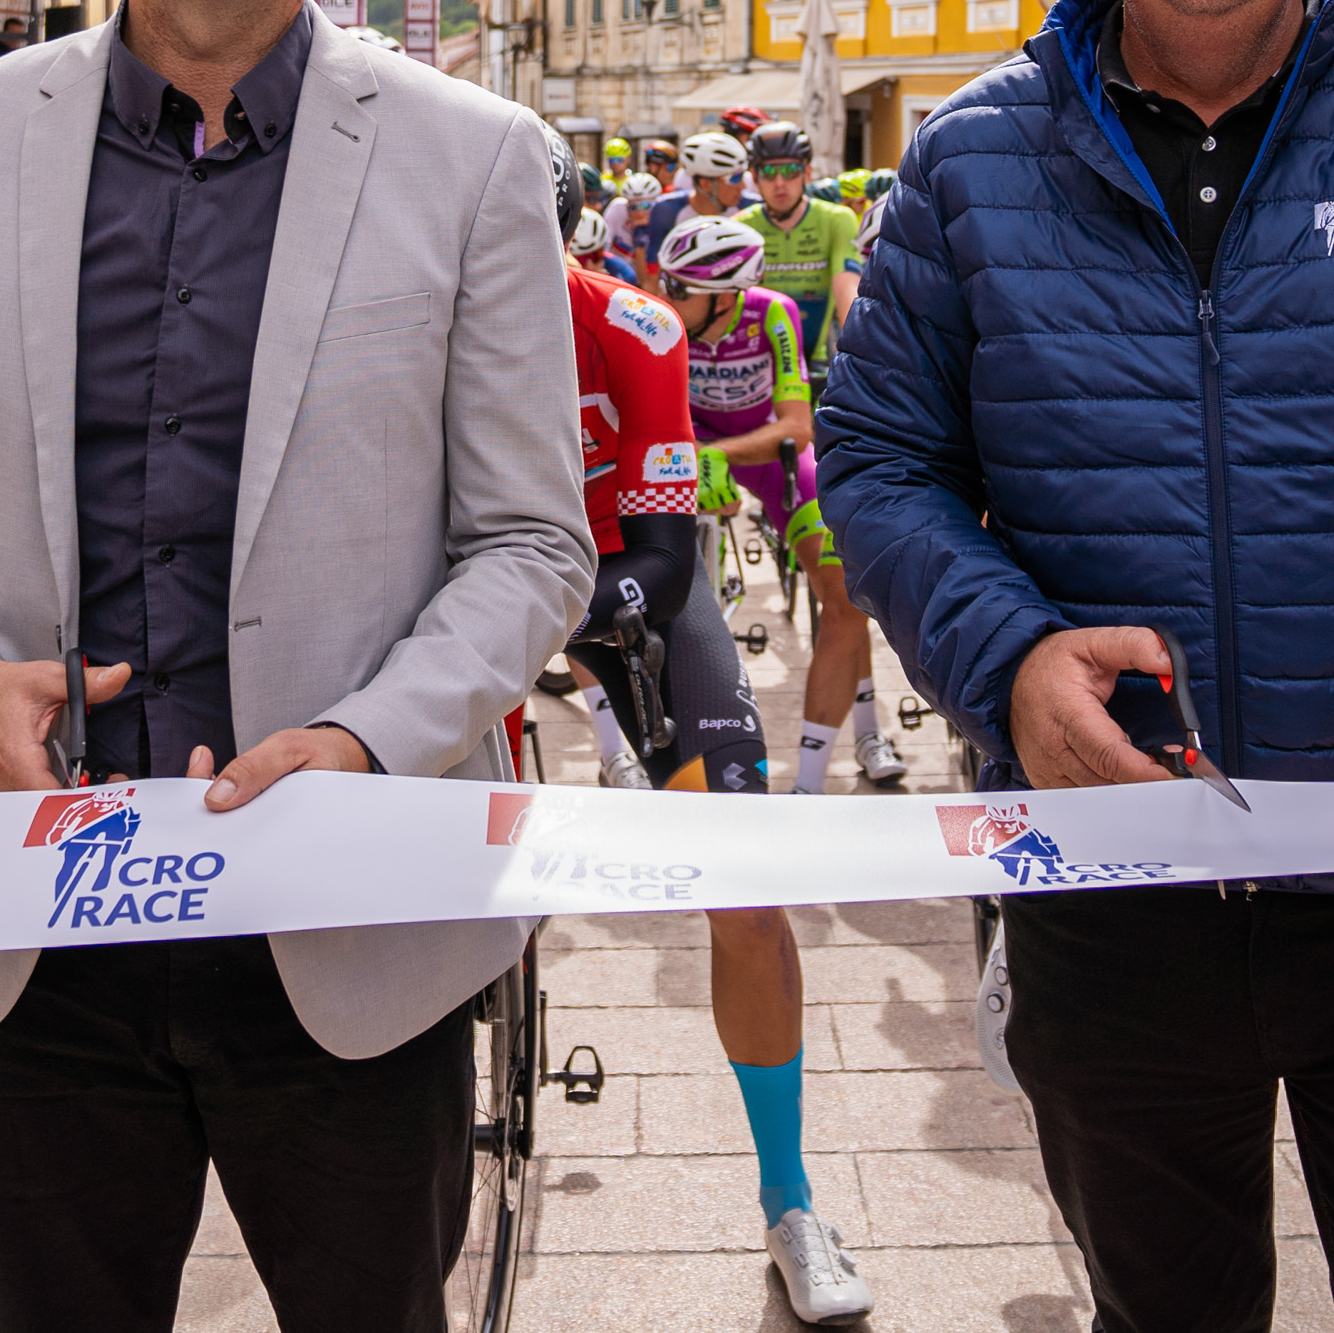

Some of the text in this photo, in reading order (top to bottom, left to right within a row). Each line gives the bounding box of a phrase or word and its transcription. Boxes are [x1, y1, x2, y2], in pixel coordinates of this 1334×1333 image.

[703, 377, 766, 400] CSF
[698, 717, 742, 730] Bapco
[117, 851, 226, 887] CRO
[594, 863, 702, 881] CRO
[1037, 869, 1177, 885] RACE
[1067, 862, 1174, 874] CRO
[565, 881, 694, 901] ACE
[70, 887, 209, 929] RACE
